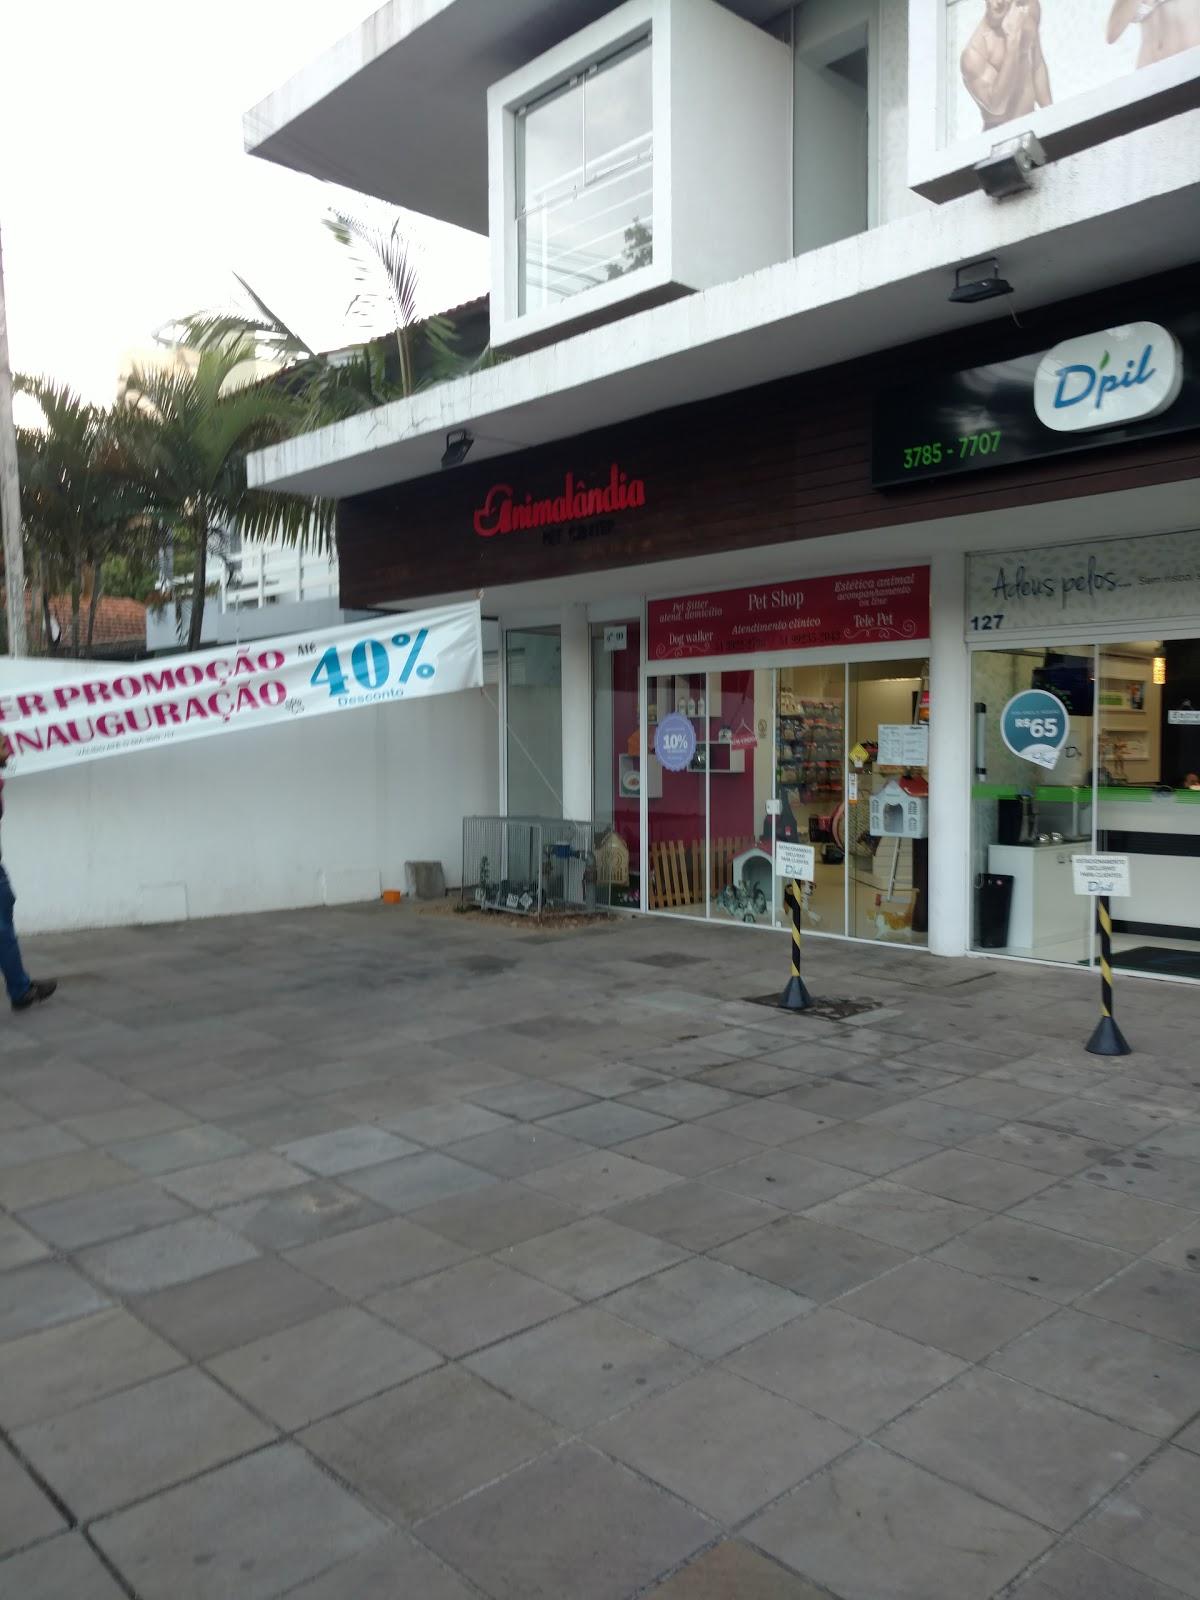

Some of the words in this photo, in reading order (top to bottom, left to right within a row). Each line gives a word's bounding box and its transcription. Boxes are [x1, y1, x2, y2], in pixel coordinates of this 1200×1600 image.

[903, 443, 942, 469] 3785
[959, 431, 1001, 459] 7707
[472, 463, 646, 537] Animalândia
[876, 573, 915, 588] animal
[992, 566, 1055, 600] Adeus
[673, 602, 684, 612] Pet
[748, 592, 767, 611] Pet
[771, 589, 804, 610] Shop
[731, 620, 787, 635] Atendimento
[853, 614, 875, 628] Tele
[876, 612, 894, 626] Pet
[971, 614, 1005, 631] 127
[669, 632, 684, 646] Dog
[685, 629, 714, 642] walker
[310, 627, 436, 697] 40%
[54, 646, 286, 710] PROMOÇÃO
[338, 688, 405, 707] Desconto
[4, 679, 288, 757] INAUGURAÇÃO
[663, 733, 688, 750] 10%
